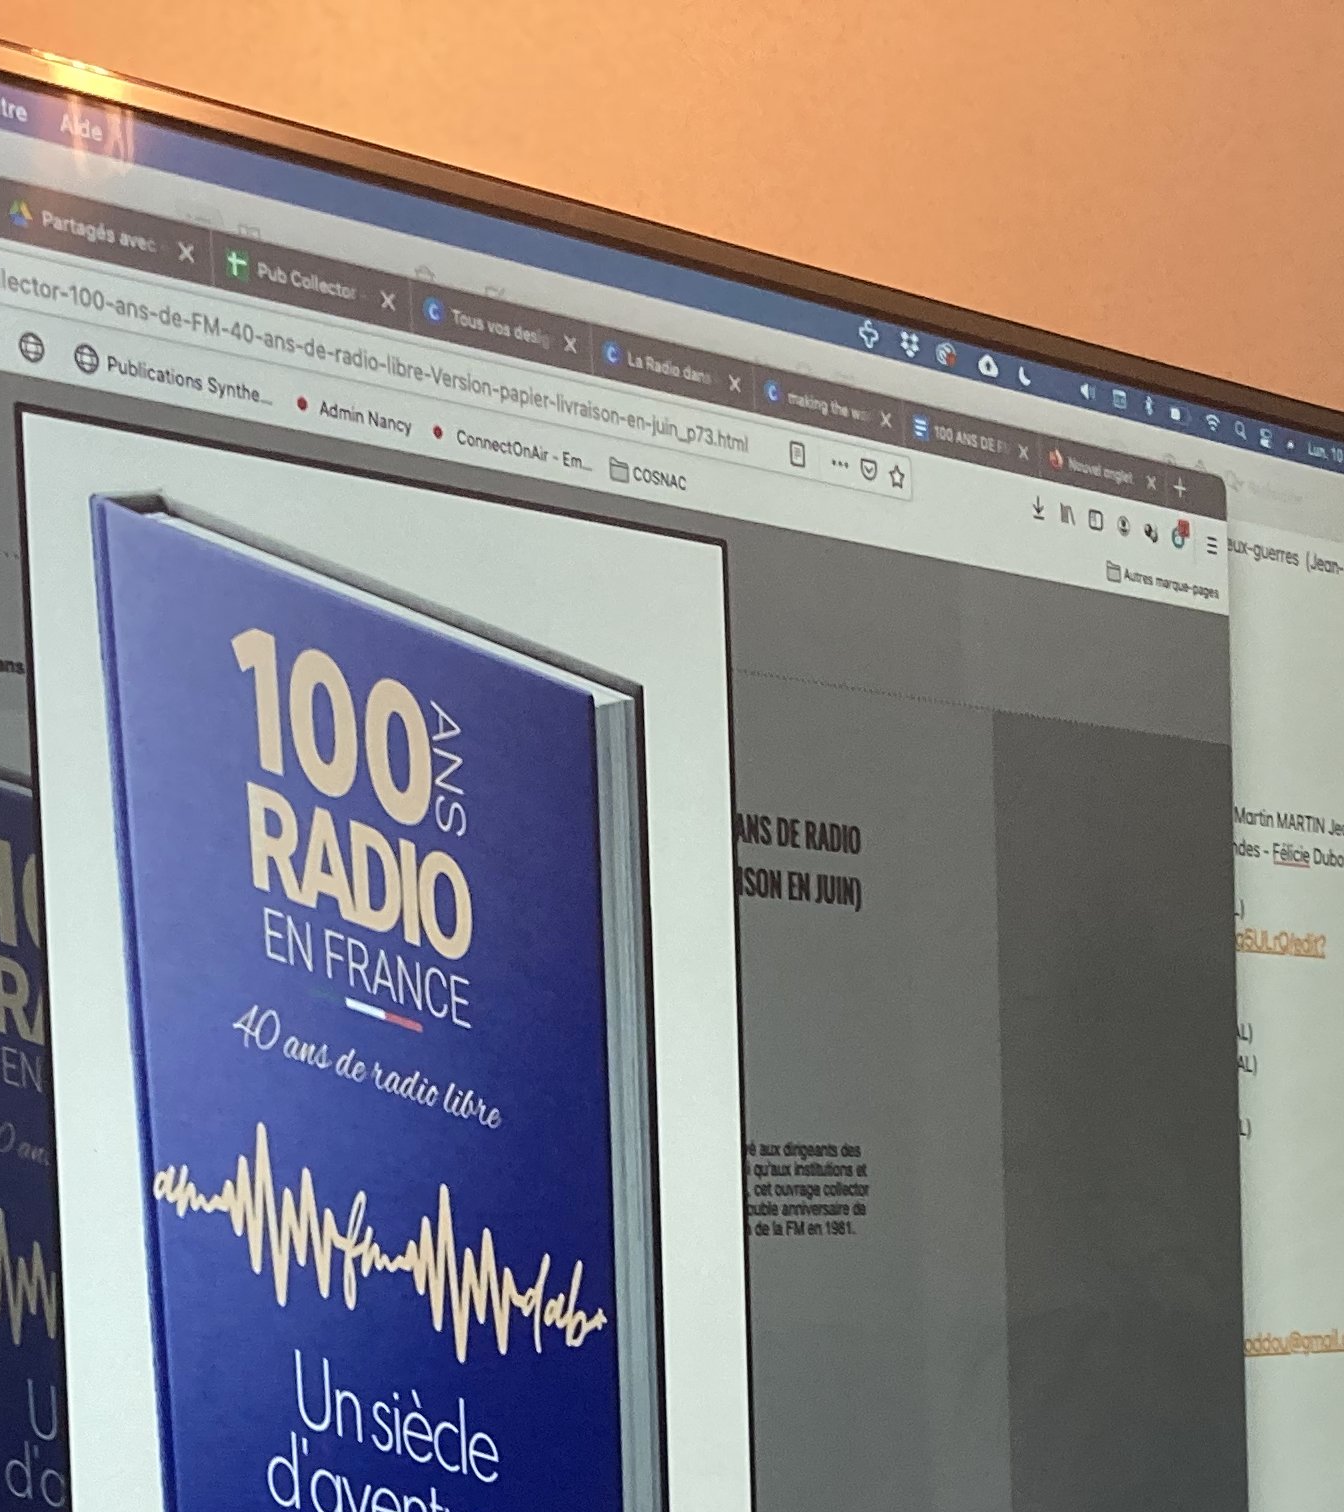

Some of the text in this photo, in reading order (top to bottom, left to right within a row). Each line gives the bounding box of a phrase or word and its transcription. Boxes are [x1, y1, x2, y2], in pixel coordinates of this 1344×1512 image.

[61, 117, 102, 142] Aide
[41, 210, 116, 244] Partagés
[258, 262, 286, 284] Pub
[450, 307, 485, 331] Tous
[488, 322, 511, 337] vos
[108, 356, 203, 391] Publications
[628, 351, 643, 369] La
[646, 356, 680, 377] Radio
[319, 400, 412, 436] Admin Nancy
[457, 429, 548, 462] ConnectOnAir
[956, 431, 978, 448] ANS
[1331, 447, 1344, 463] 10
[633, 466, 687, 492] COSNAC
[230, 627, 433, 827] 100
[429, 700, 467, 838] ANS
[777, 817, 801, 849] DE
[805, 820, 861, 855] RADIO
[1234, 806, 1274, 828] Martin
[1276, 811, 1325, 834] MARTIN
[1273, 843, 1310, 863] Félicie
[246, 781, 473, 960] RADIO
[787, 871, 811, 901] EN
[815, 873, 862, 913] JUIN)
[264, 906, 473, 1030] EN FRANCE
[1, 1046, 43, 1093] EN
[232, 1003, 502, 1130] 40 ans de radio libre
[786, 1221, 805, 1236] FM
[294, 1349, 499, 1483] Un siècle
